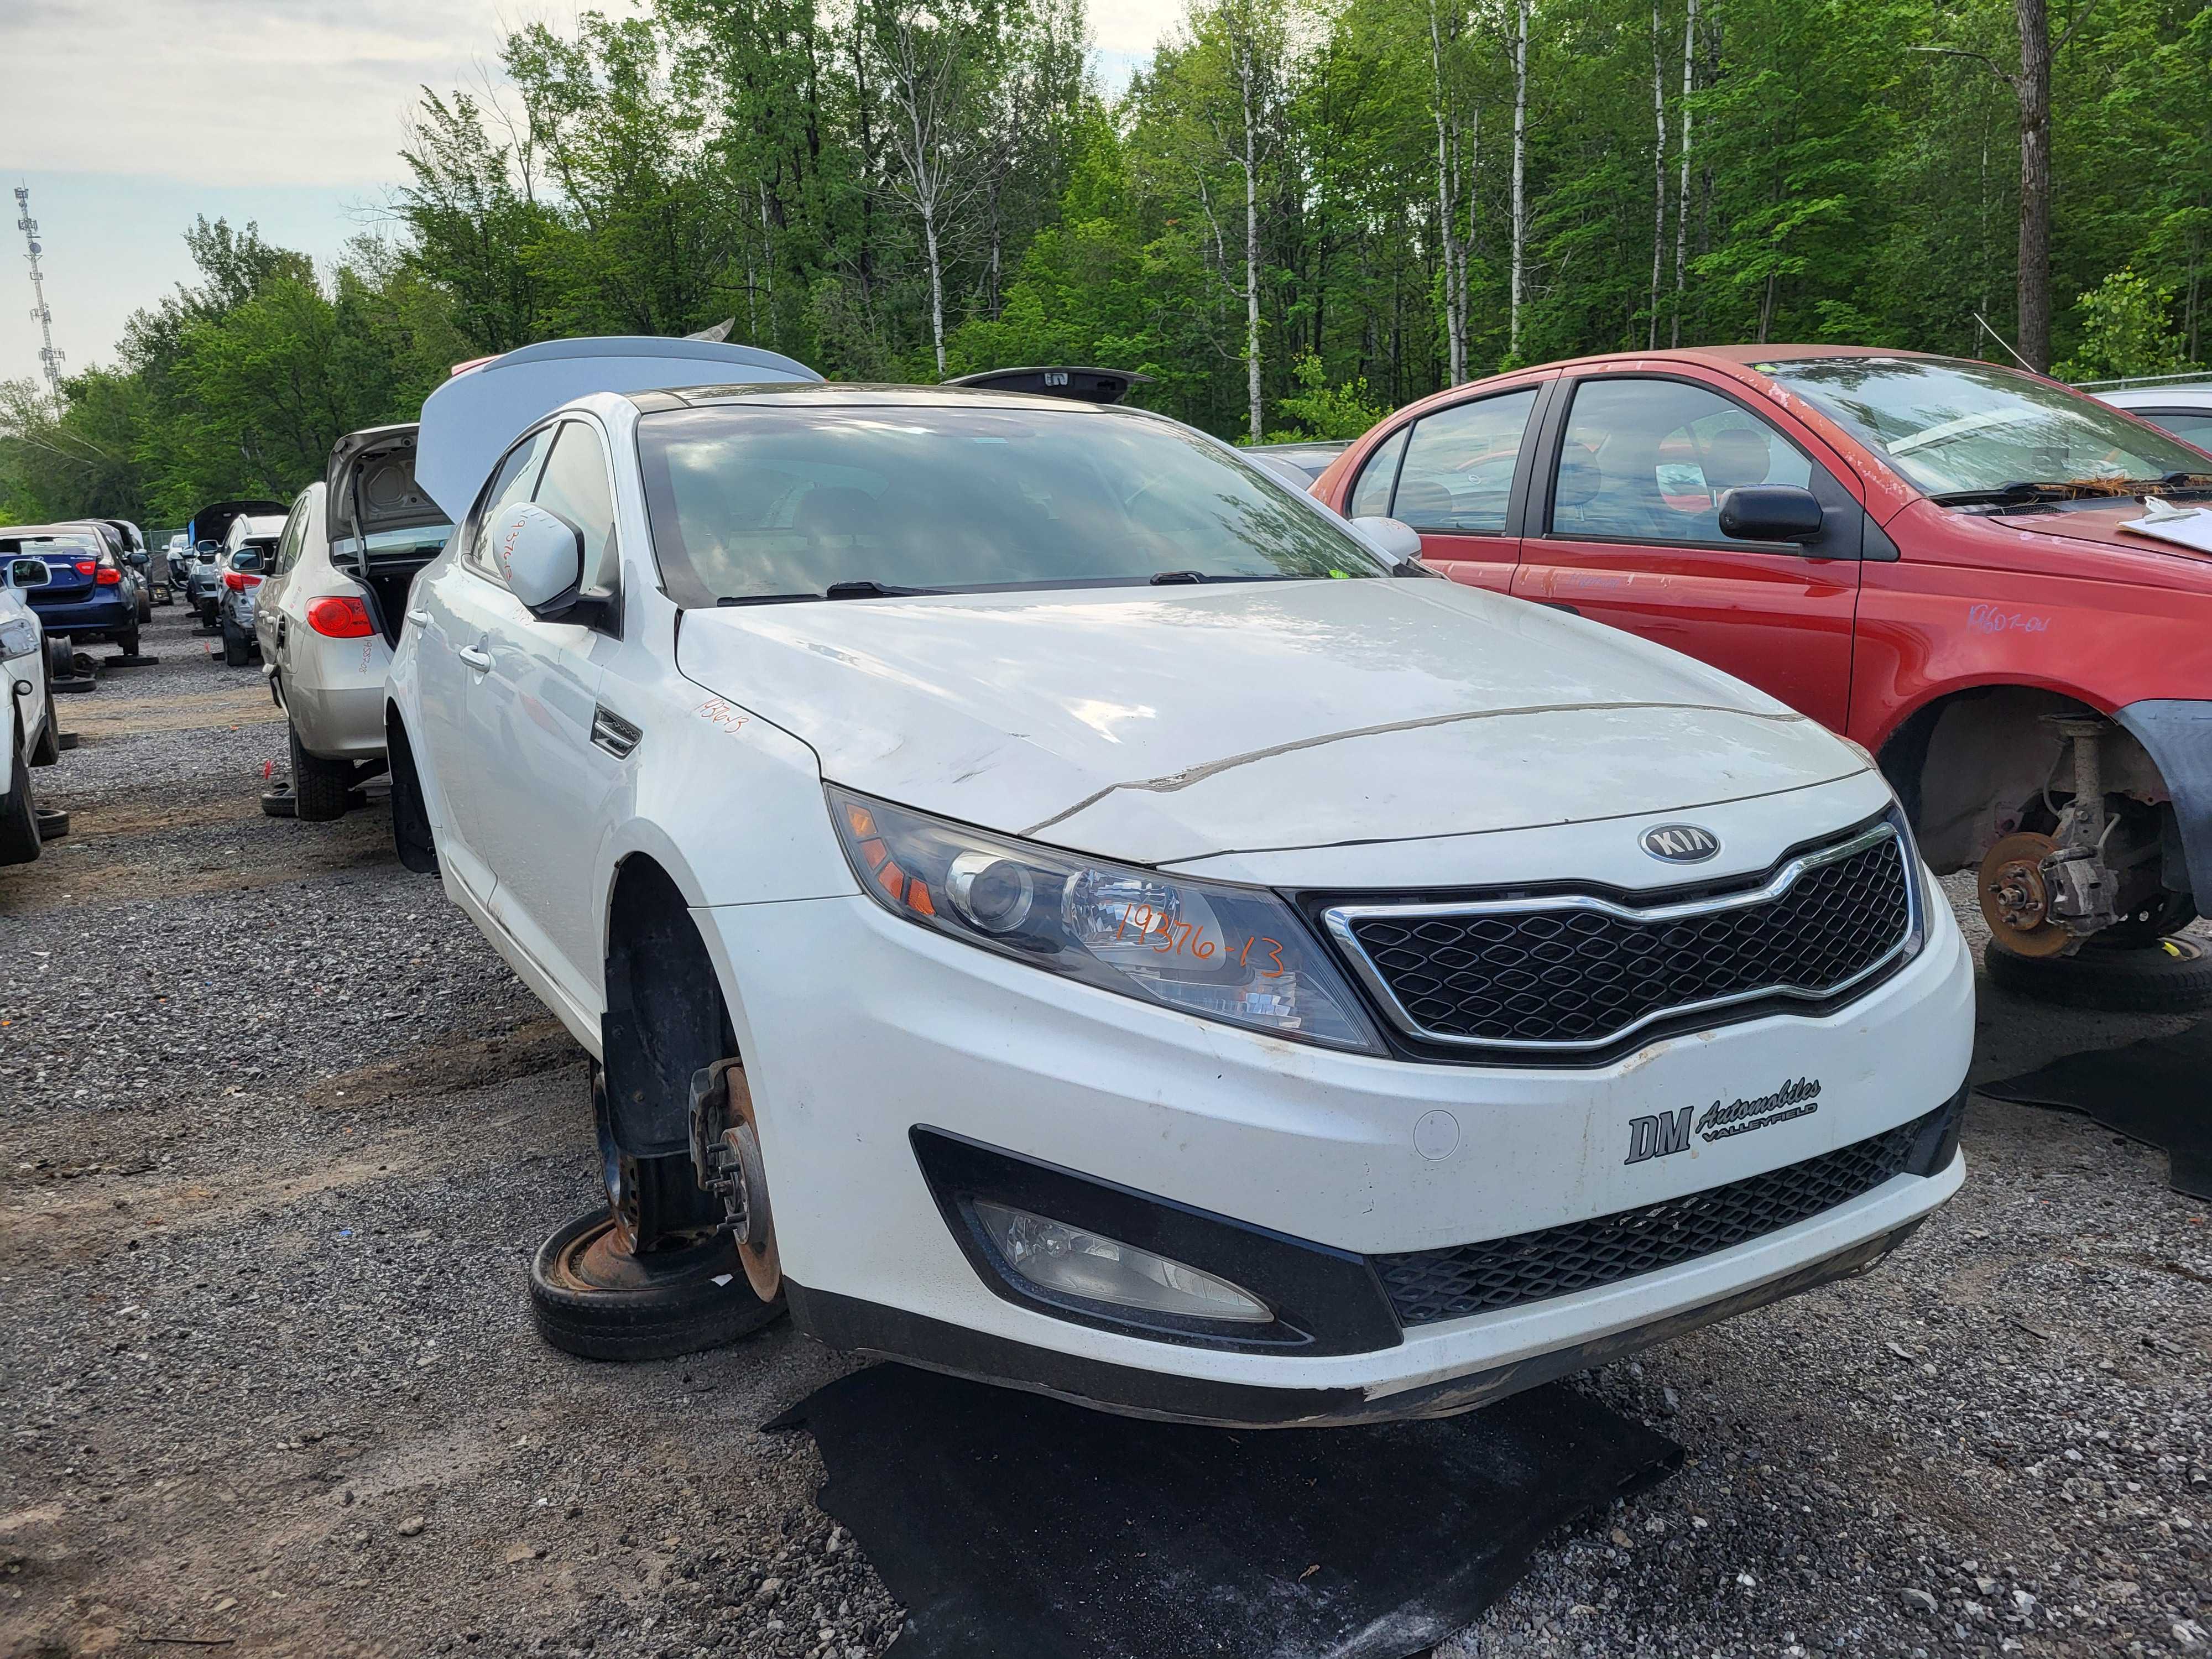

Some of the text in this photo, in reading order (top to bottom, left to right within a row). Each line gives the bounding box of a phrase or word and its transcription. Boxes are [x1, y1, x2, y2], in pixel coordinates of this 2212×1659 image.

[1650, 829, 1715, 855] KIA
[1116, 902, 1284, 978] 19376-13
[1624, 1077, 1822, 1165] DM Automobiles
[1702, 1102, 1818, 1142] VALLEYFIELD
